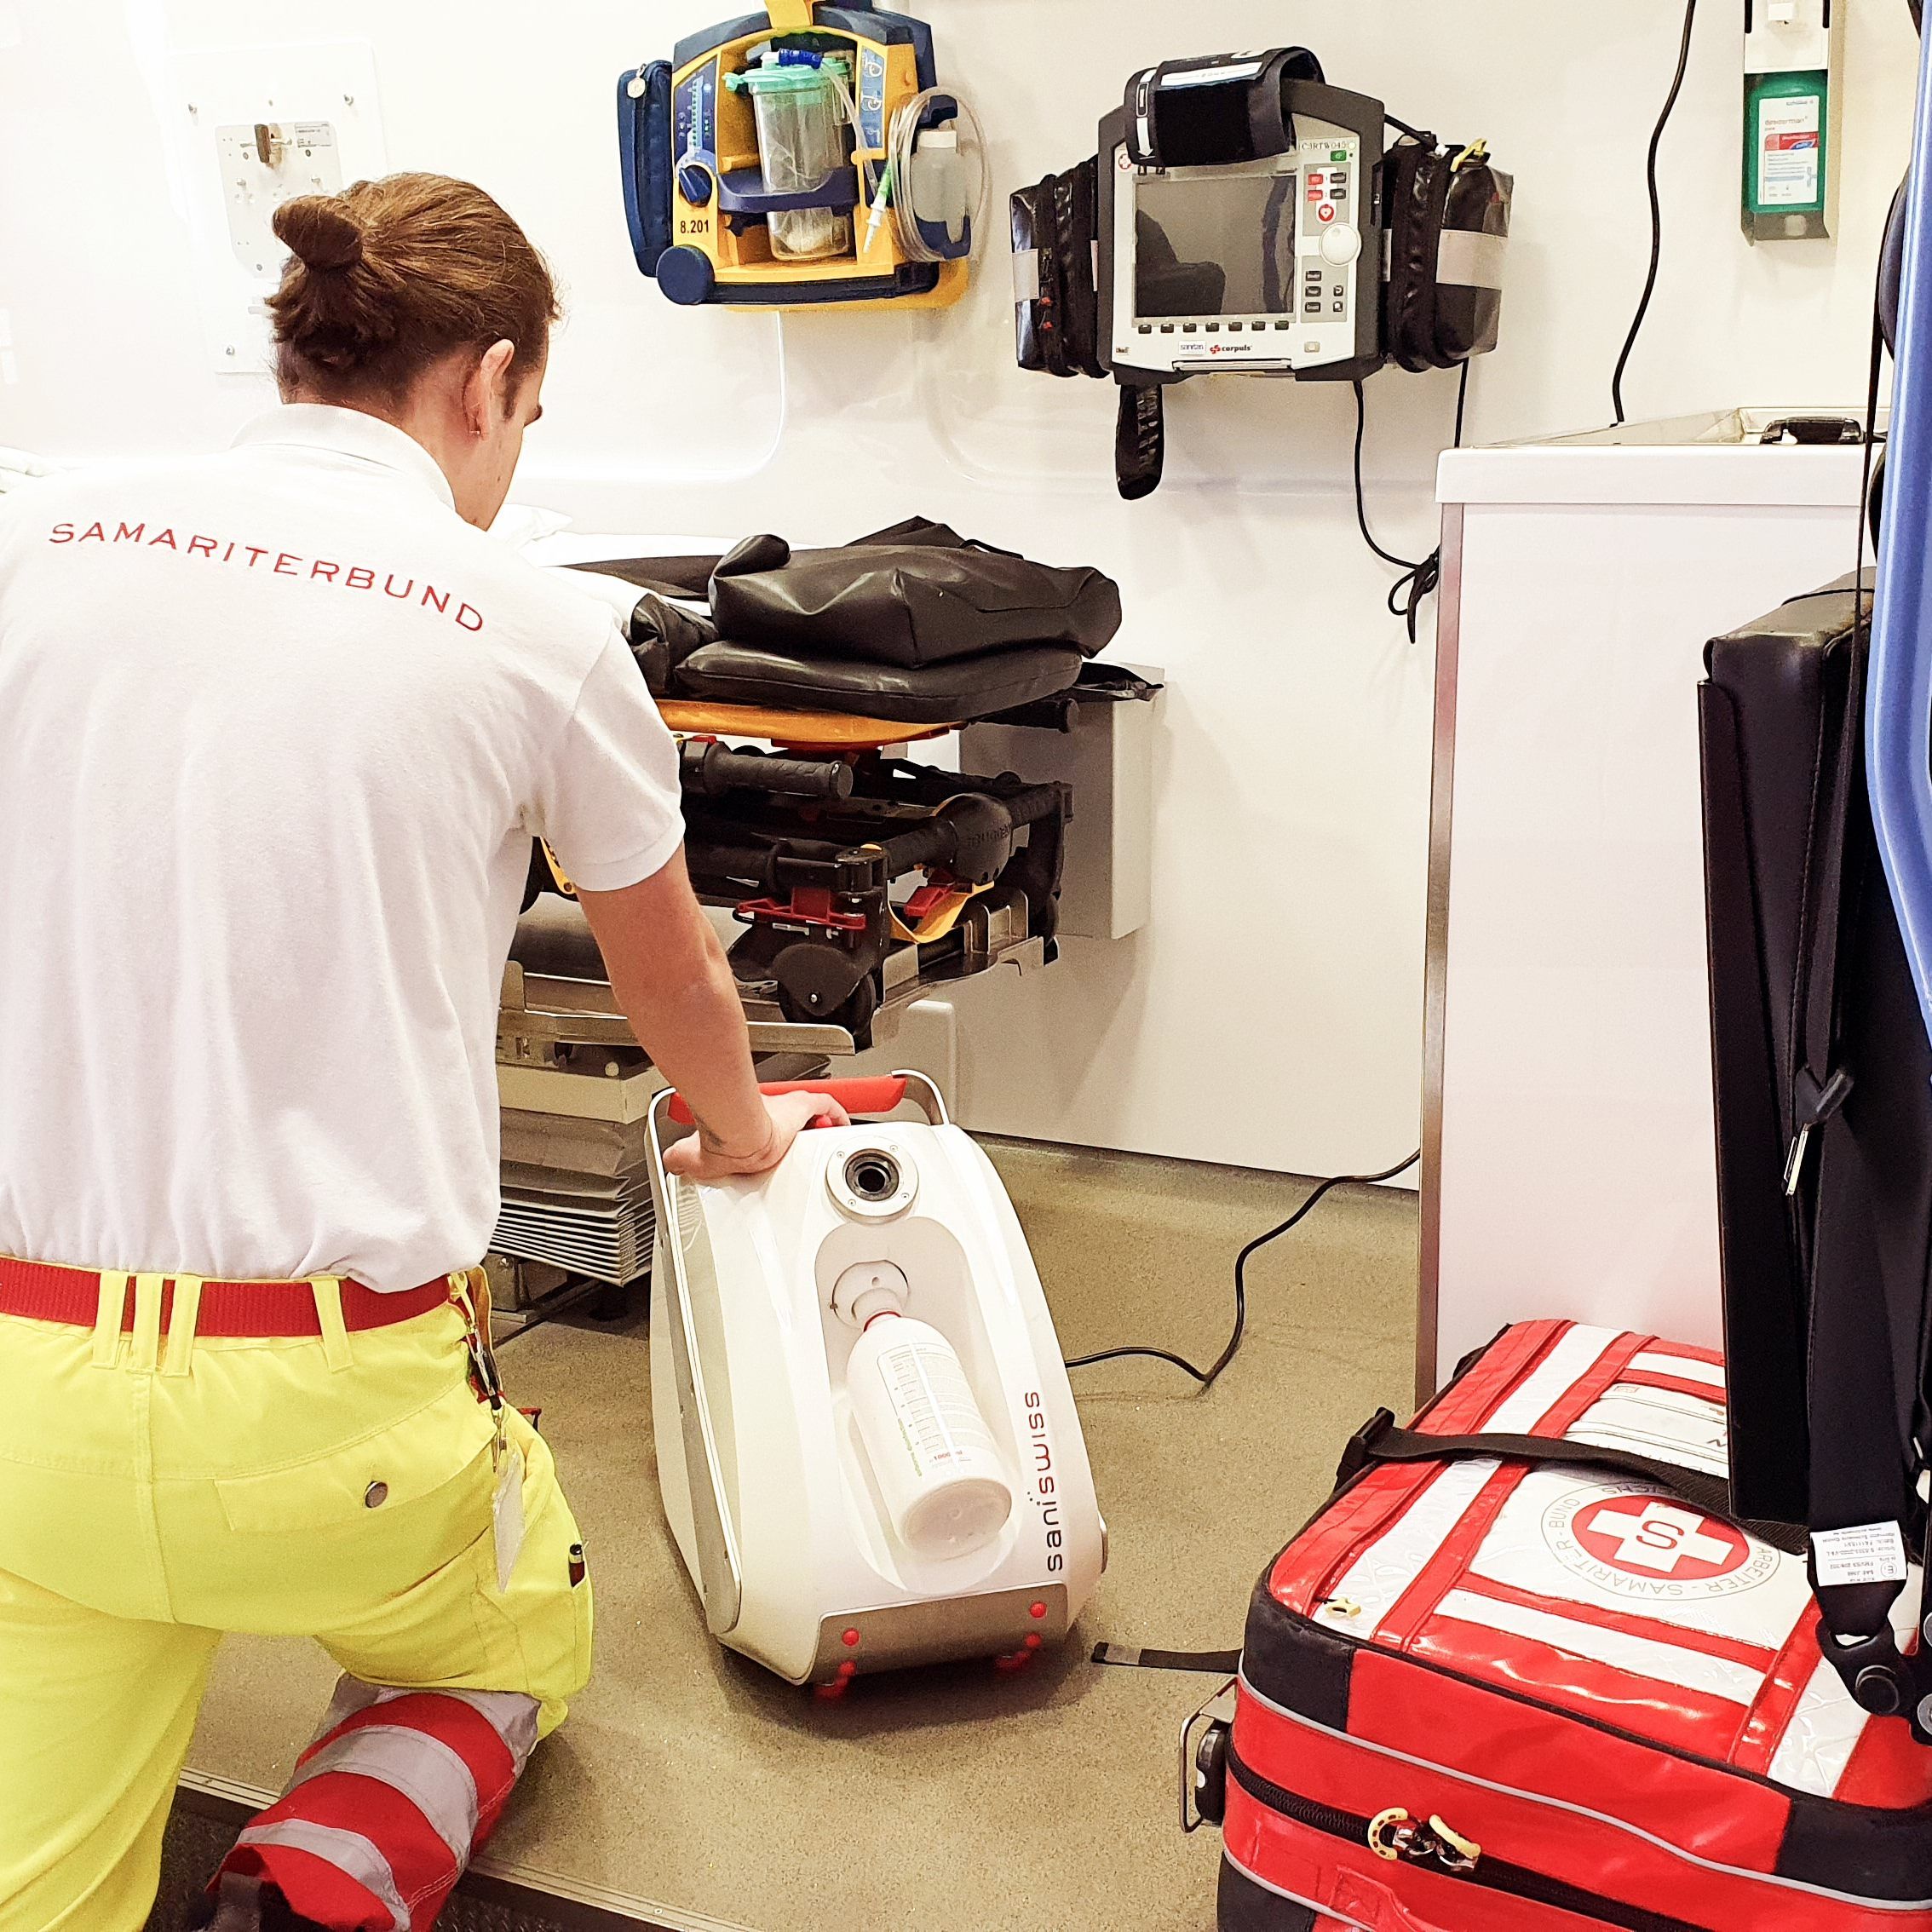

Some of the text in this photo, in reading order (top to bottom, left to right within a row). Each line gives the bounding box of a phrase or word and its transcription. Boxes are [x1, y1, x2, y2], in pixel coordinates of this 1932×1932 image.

[680, 219, 709, 233] 8.201
[1222, 344, 1251, 354] corpuls
[49, 521, 484, 633] SAMARITERBUND
[1636, 1520, 1684, 1550] S
